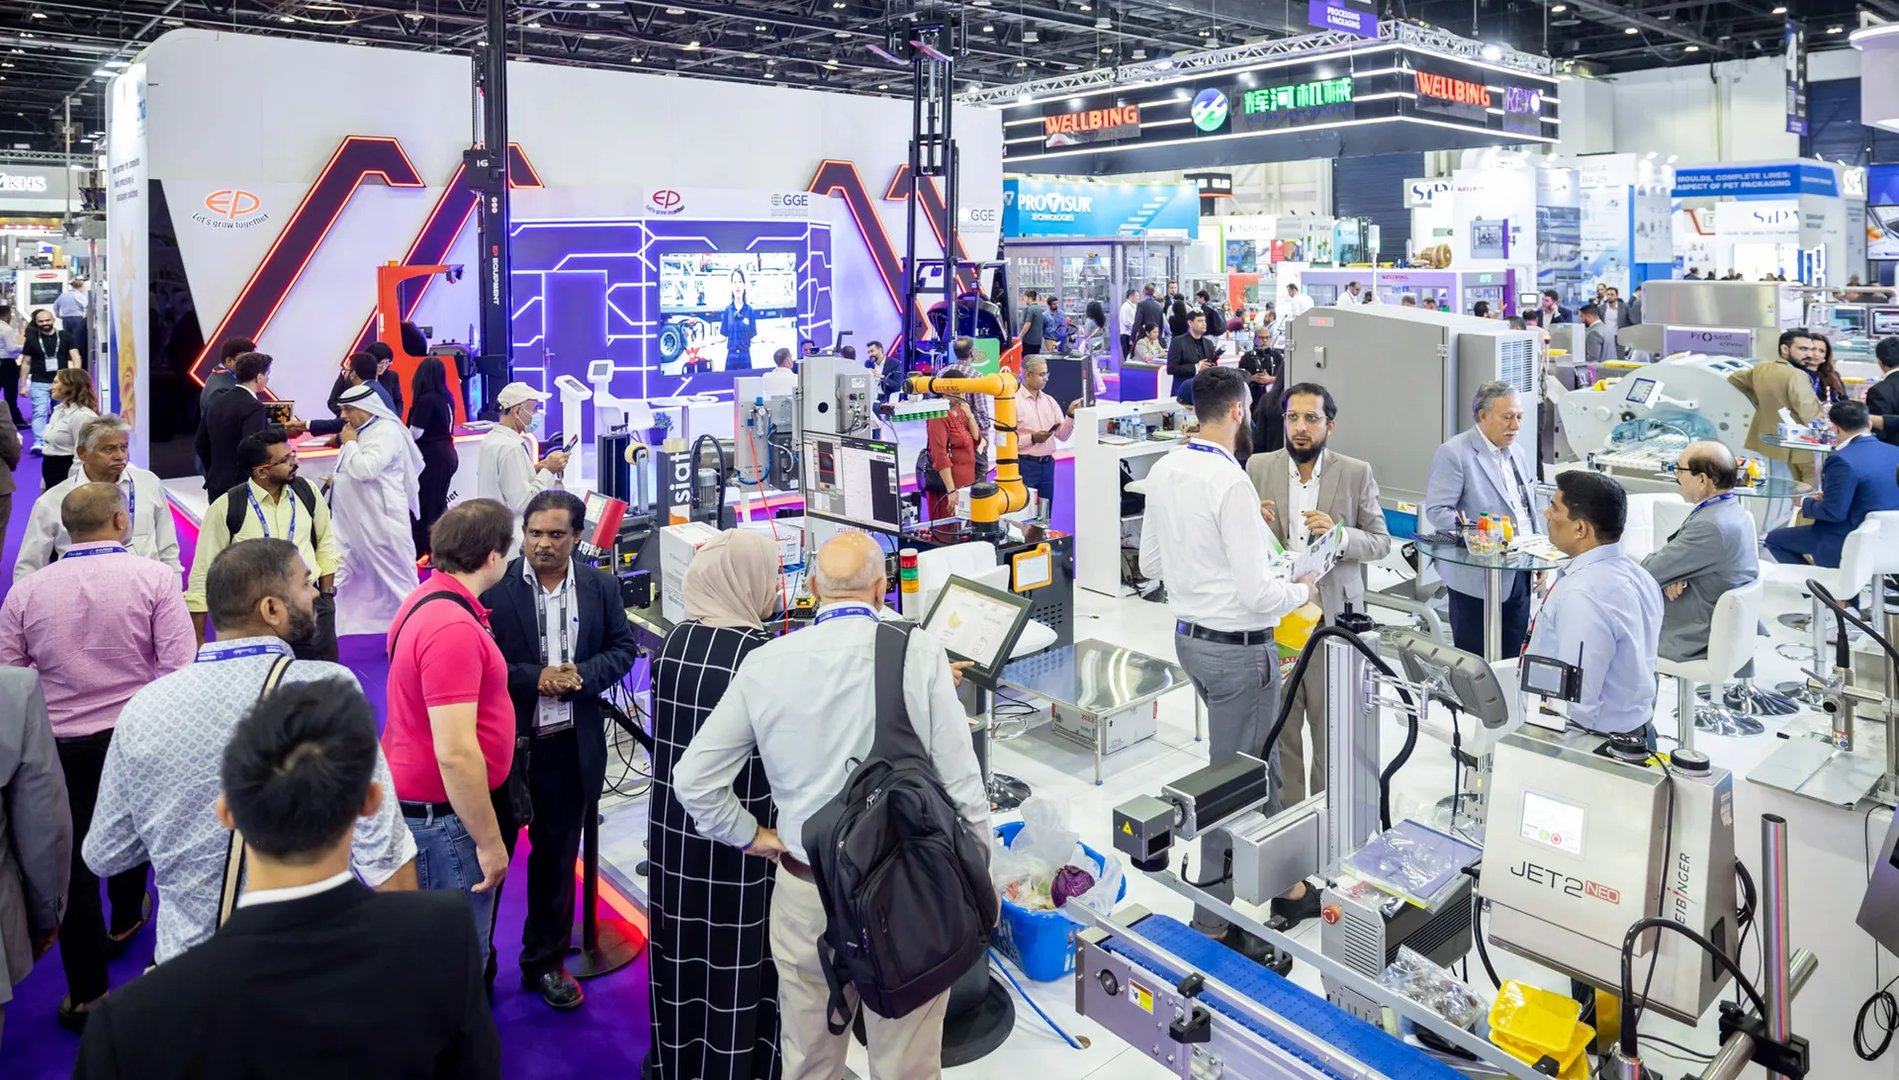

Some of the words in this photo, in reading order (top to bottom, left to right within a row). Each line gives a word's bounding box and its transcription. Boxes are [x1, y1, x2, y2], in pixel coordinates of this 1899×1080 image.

[1327, 6, 1360, 21] PROCESSING
[1333, 16, 1360, 30] PACKAGING
[1244, 76, 1353, 114] 辉河机械
[1416, 71, 1491, 108] WELLBING
[1045, 105, 1138, 134] WELLBING
[8, 176, 45, 190] KHS
[1677, 174, 1714, 183] MOULDS,
[1715, 173, 1760, 181] COMPLETE
[1677, 182, 1708, 190] ASPECT
[1709, 182, 1721, 190] OF
[1722, 181, 1739, 189] PET
[1741, 179, 1792, 188] PACKAGING
[205, 189, 261, 219] EP
[652, 190, 681, 209] EP
[782, 194, 809, 206] GGE
[1018, 192, 1093, 214] PROVISUR
[192, 212, 212, 226] Let's
[212, 219, 234, 229] grow
[235, 213, 269, 229] together
[971, 209, 995, 221] GGE
[1031, 213, 1075, 223] TECHNOLOGIES
[492, 258, 500, 305] EQUIPMENT
[669, 453, 690, 503] siat
[1585, 881, 1620, 904] NEO
[1666, 852, 1697, 925] EIBINGER
